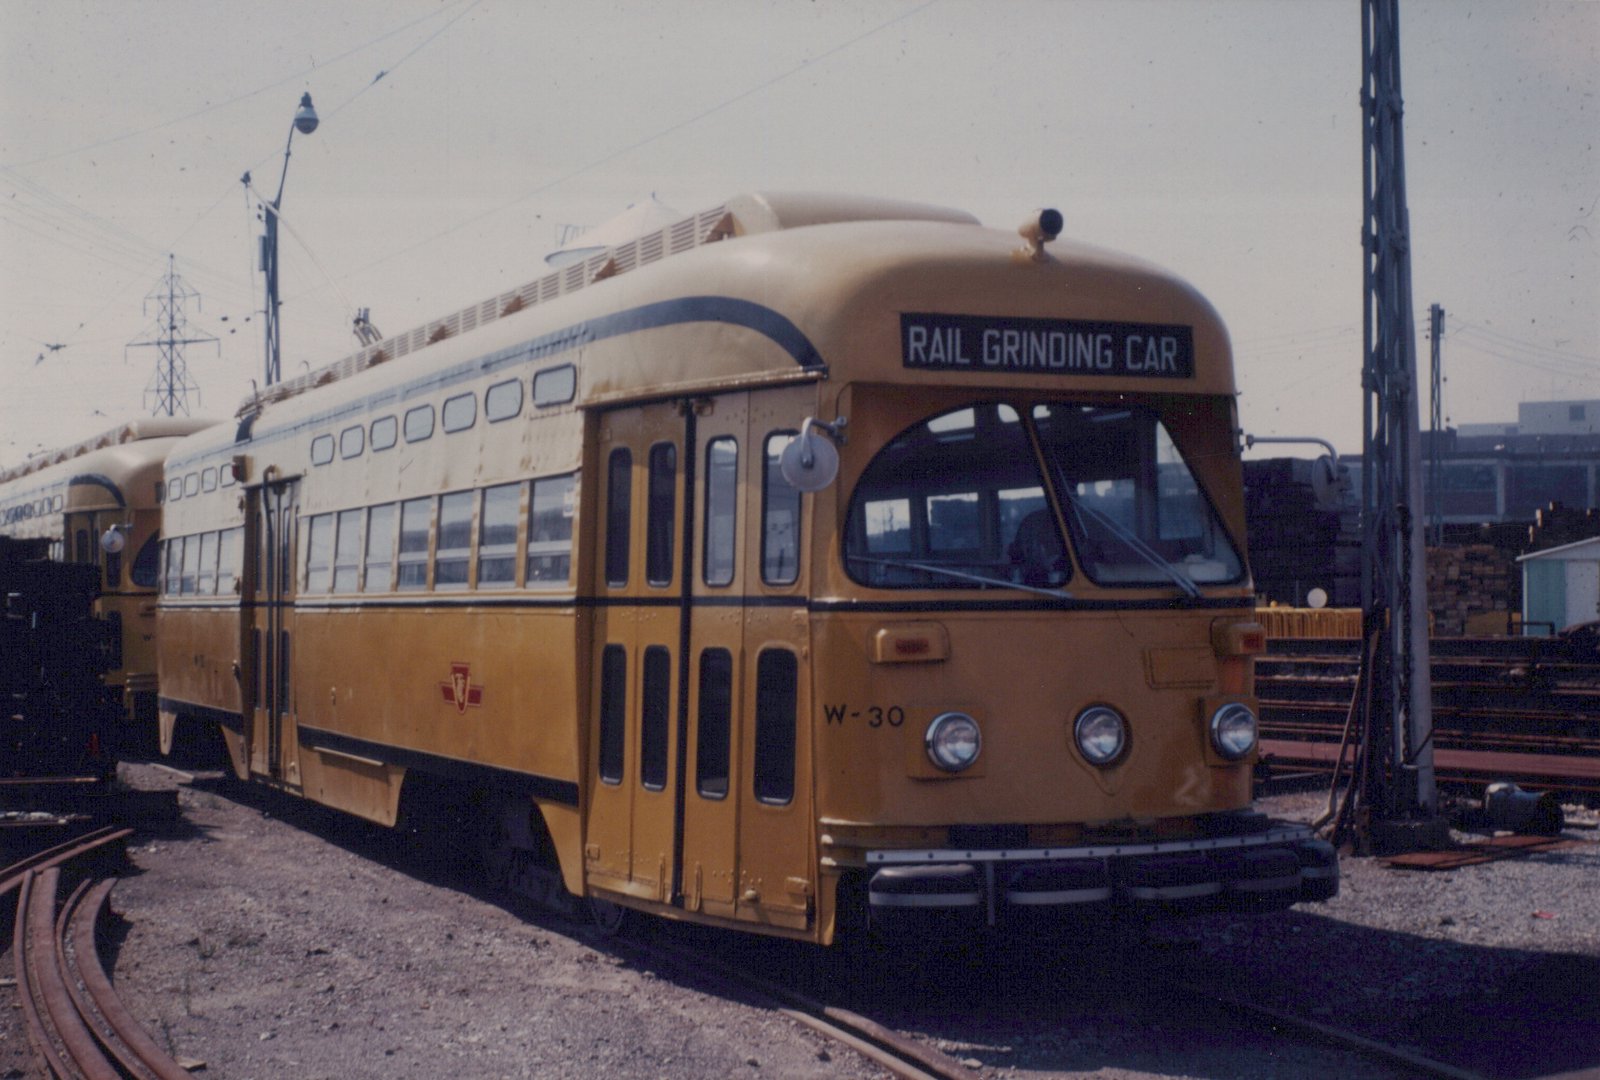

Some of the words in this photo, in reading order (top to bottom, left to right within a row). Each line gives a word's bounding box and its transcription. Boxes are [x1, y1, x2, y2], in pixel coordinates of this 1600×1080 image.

[908, 325, 970, 364] RAIL
[982, 329, 1113, 369] GRINDING
[1126, 334, 1177, 371] CAR
[823, 703, 905, 729] W-30
